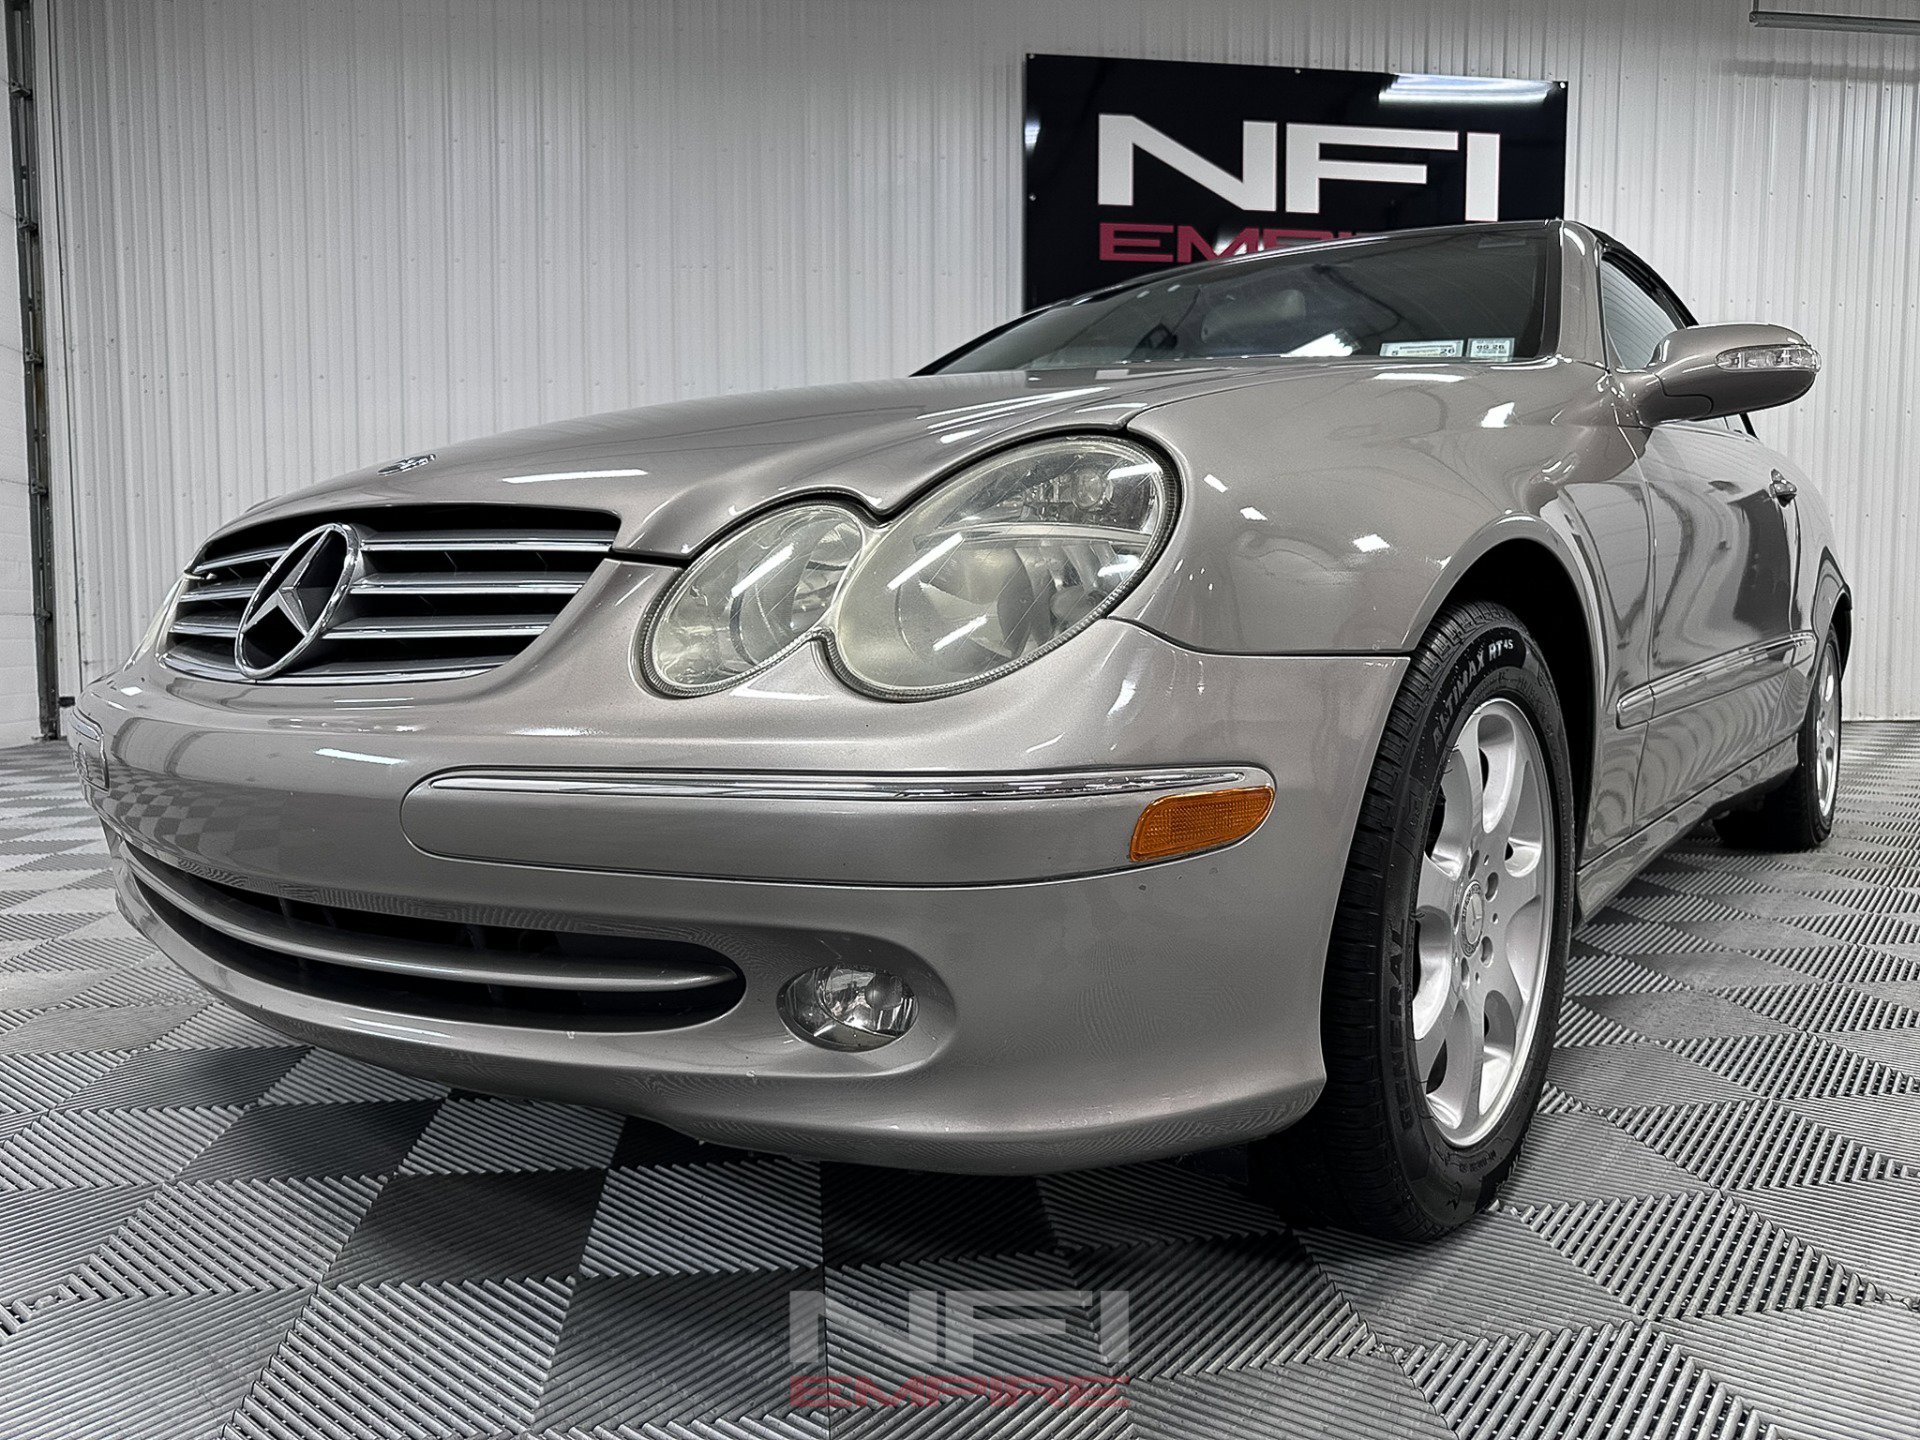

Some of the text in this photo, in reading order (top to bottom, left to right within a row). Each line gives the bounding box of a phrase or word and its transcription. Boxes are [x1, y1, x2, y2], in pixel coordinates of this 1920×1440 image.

[1098, 113, 1500, 222] NFI
[1099, 222, 1374, 263] EMP
[1432, 647, 1485, 754] ALTIMAX
[1388, 918, 1414, 1131] GENERAL
